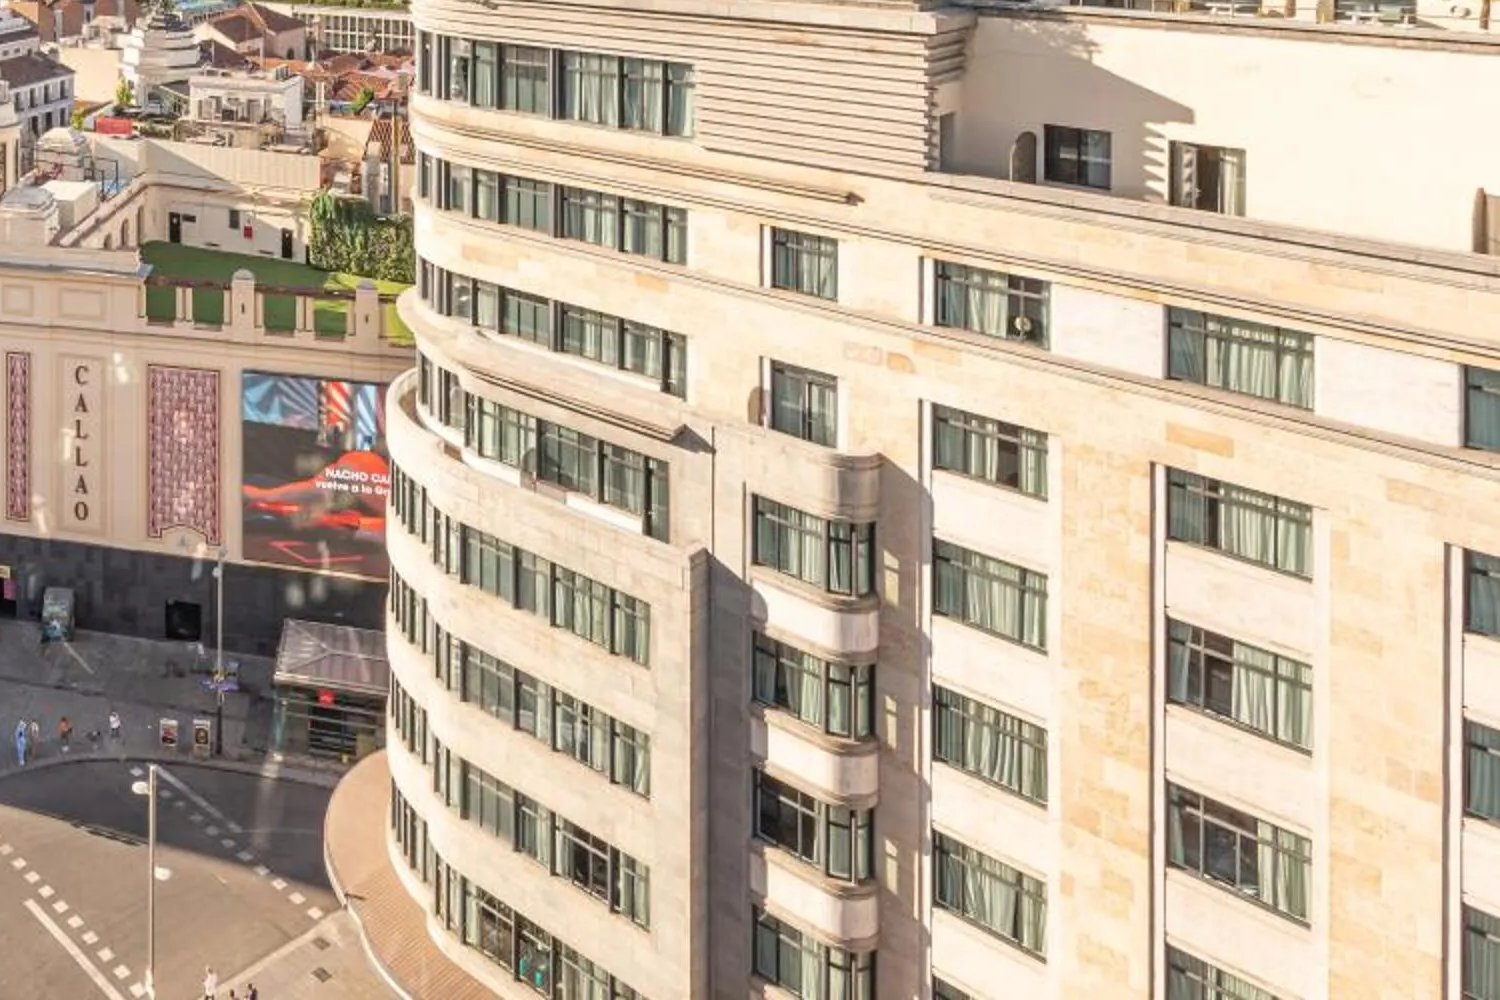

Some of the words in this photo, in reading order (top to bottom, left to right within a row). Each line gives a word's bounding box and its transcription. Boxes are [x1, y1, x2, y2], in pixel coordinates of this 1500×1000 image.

[74, 365, 89, 521] CALLAO
[325, 467, 368, 482] NACHO
[315, 480, 349, 492] vuelve
